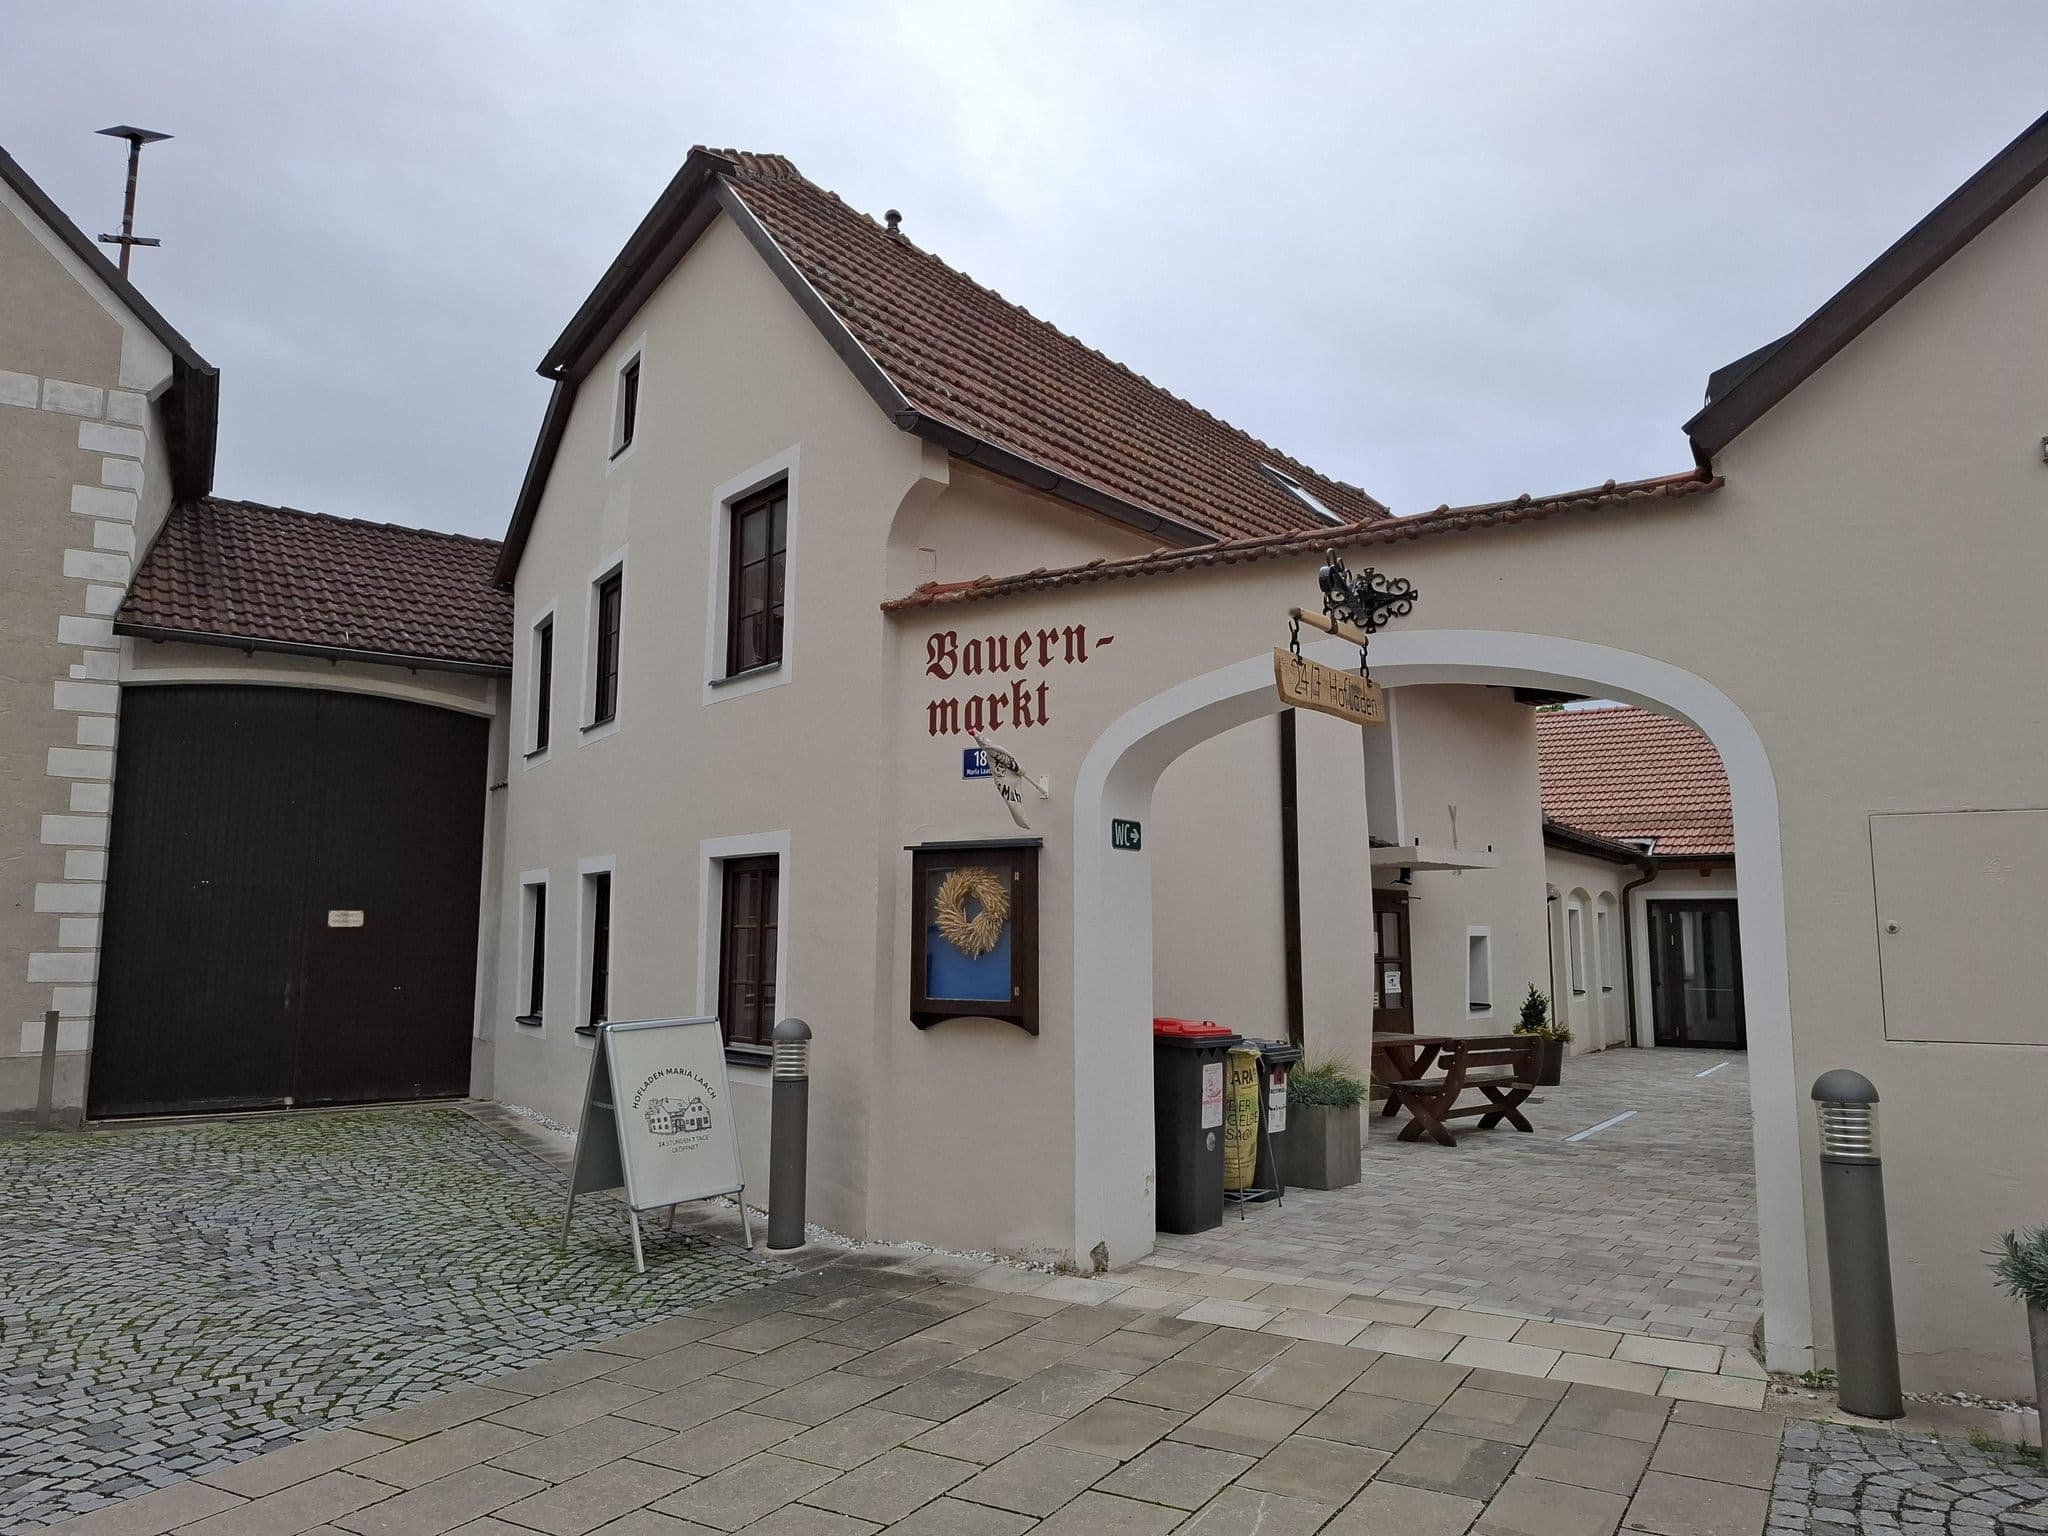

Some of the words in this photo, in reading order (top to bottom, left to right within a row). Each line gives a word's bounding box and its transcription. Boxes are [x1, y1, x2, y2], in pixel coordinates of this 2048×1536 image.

[926, 624, 1114, 680] Bauern-
[926, 679, 1050, 737] markt
[1329, 671, 1378, 717] Hofladen
[974, 750, 987, 767] 18
[980, 767, 993, 776] Laac
[1115, 822, 1130, 847] WC
[632, 1069, 664, 1110] HOFLADEN
[666, 1068, 692, 1078] MARIA
[694, 1074, 717, 1100] LAACH
